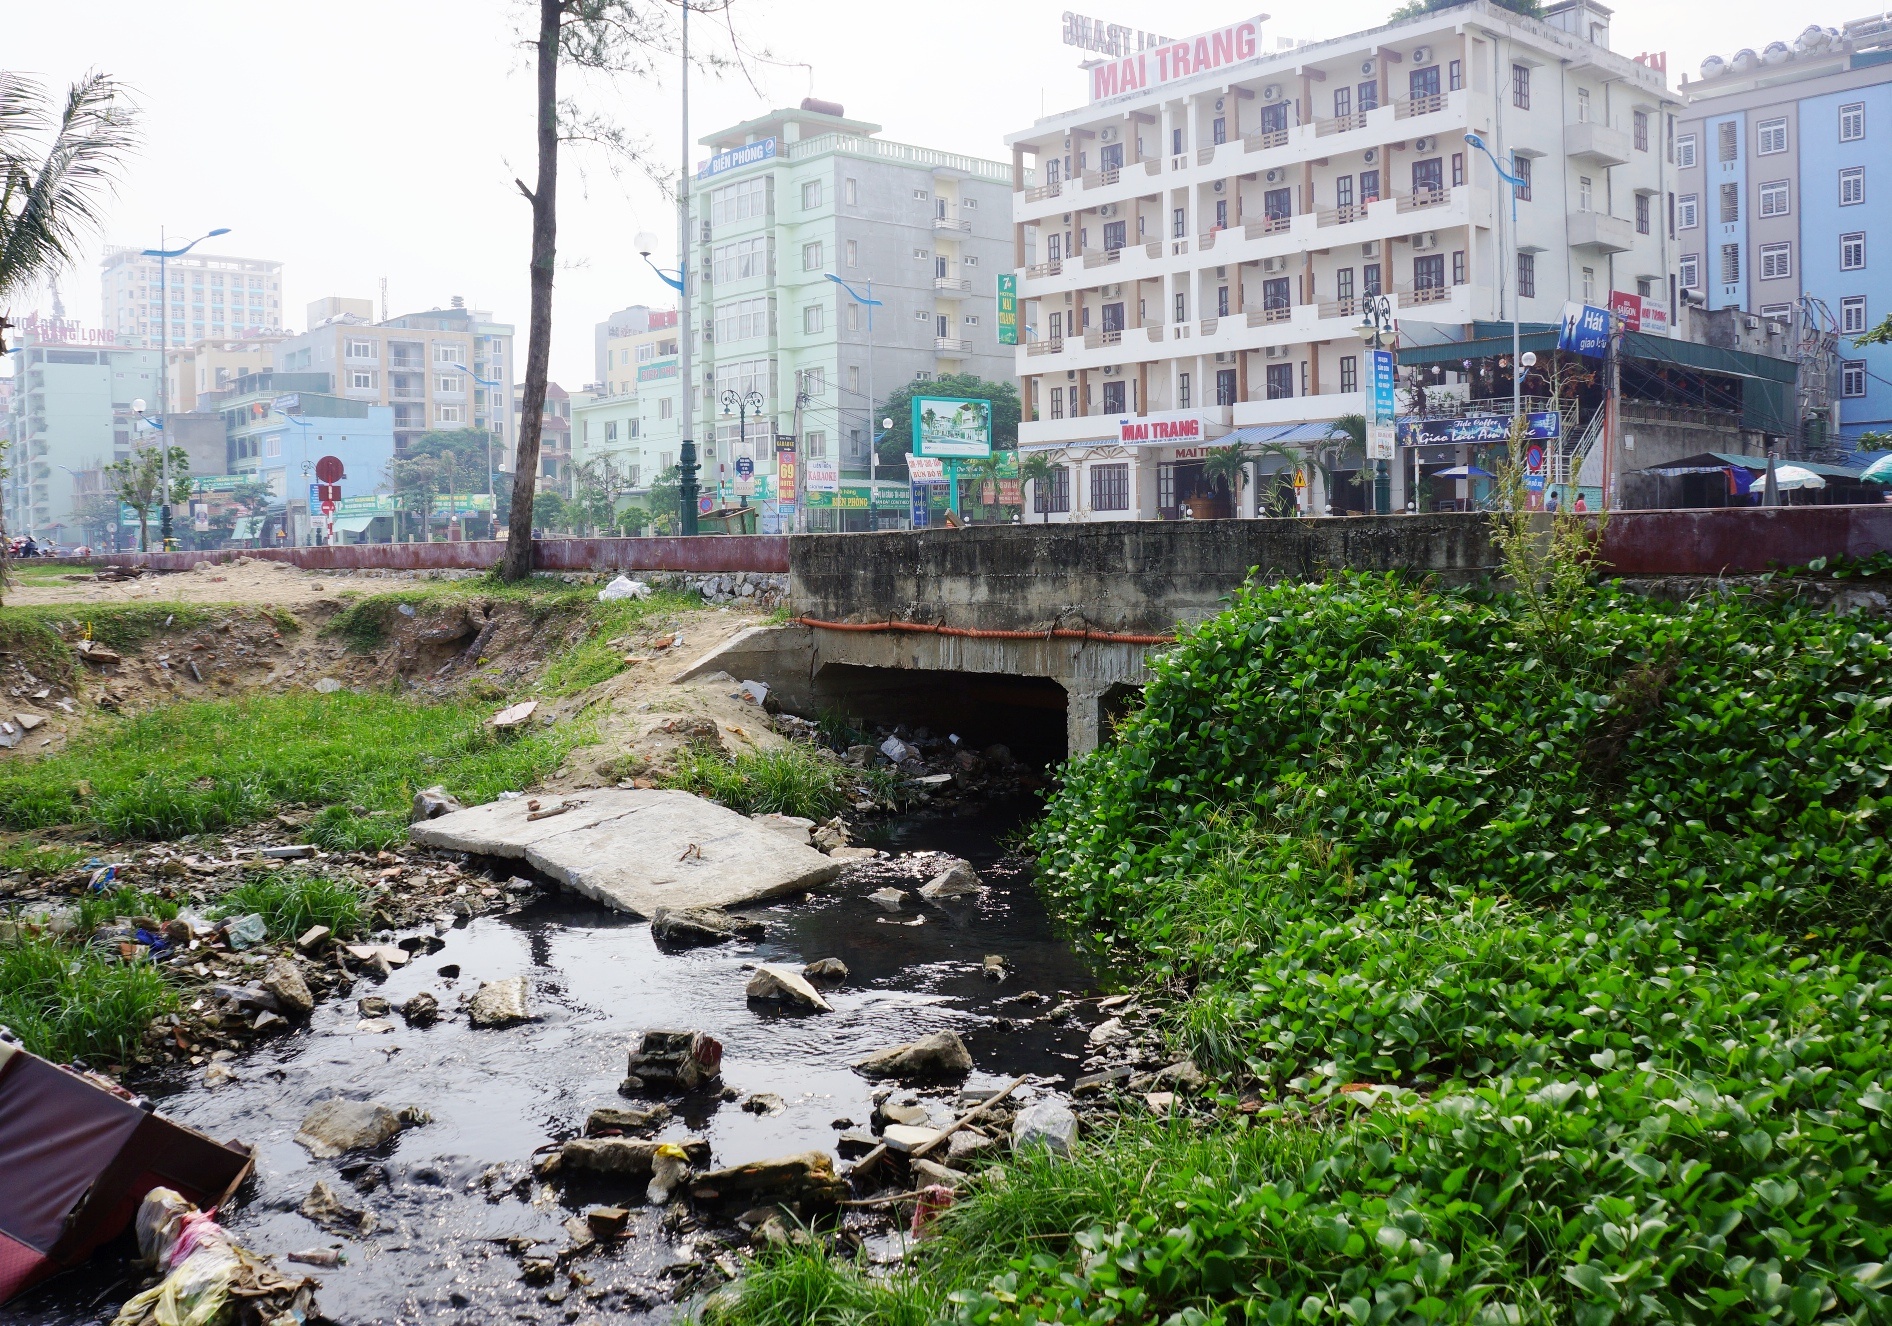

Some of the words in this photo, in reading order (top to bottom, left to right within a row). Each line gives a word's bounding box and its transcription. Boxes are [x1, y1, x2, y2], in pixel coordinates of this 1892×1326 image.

[1095, 55, 1146, 100] MAI
[1155, 23, 1256, 82] TRANG
[713, 155, 731, 173] BIÊN
[732, 145, 764, 166] PHÒNG
[999, 311, 1016, 325] TRANG
[1584, 310, 1604, 332] Hát
[81, 328, 115, 342] LONG
[1580, 338, 1595, 350] giao
[1121, 423, 1149, 441] MAI
[1151, 419, 1199, 439] TRANG
[1419, 432, 1449, 444] Giao
[1175, 447, 1197, 458] MAI
[780, 463, 795, 479] 69
[808, 471, 837, 481] KARAOKE
[847, 495, 868, 507] PHÒNG
